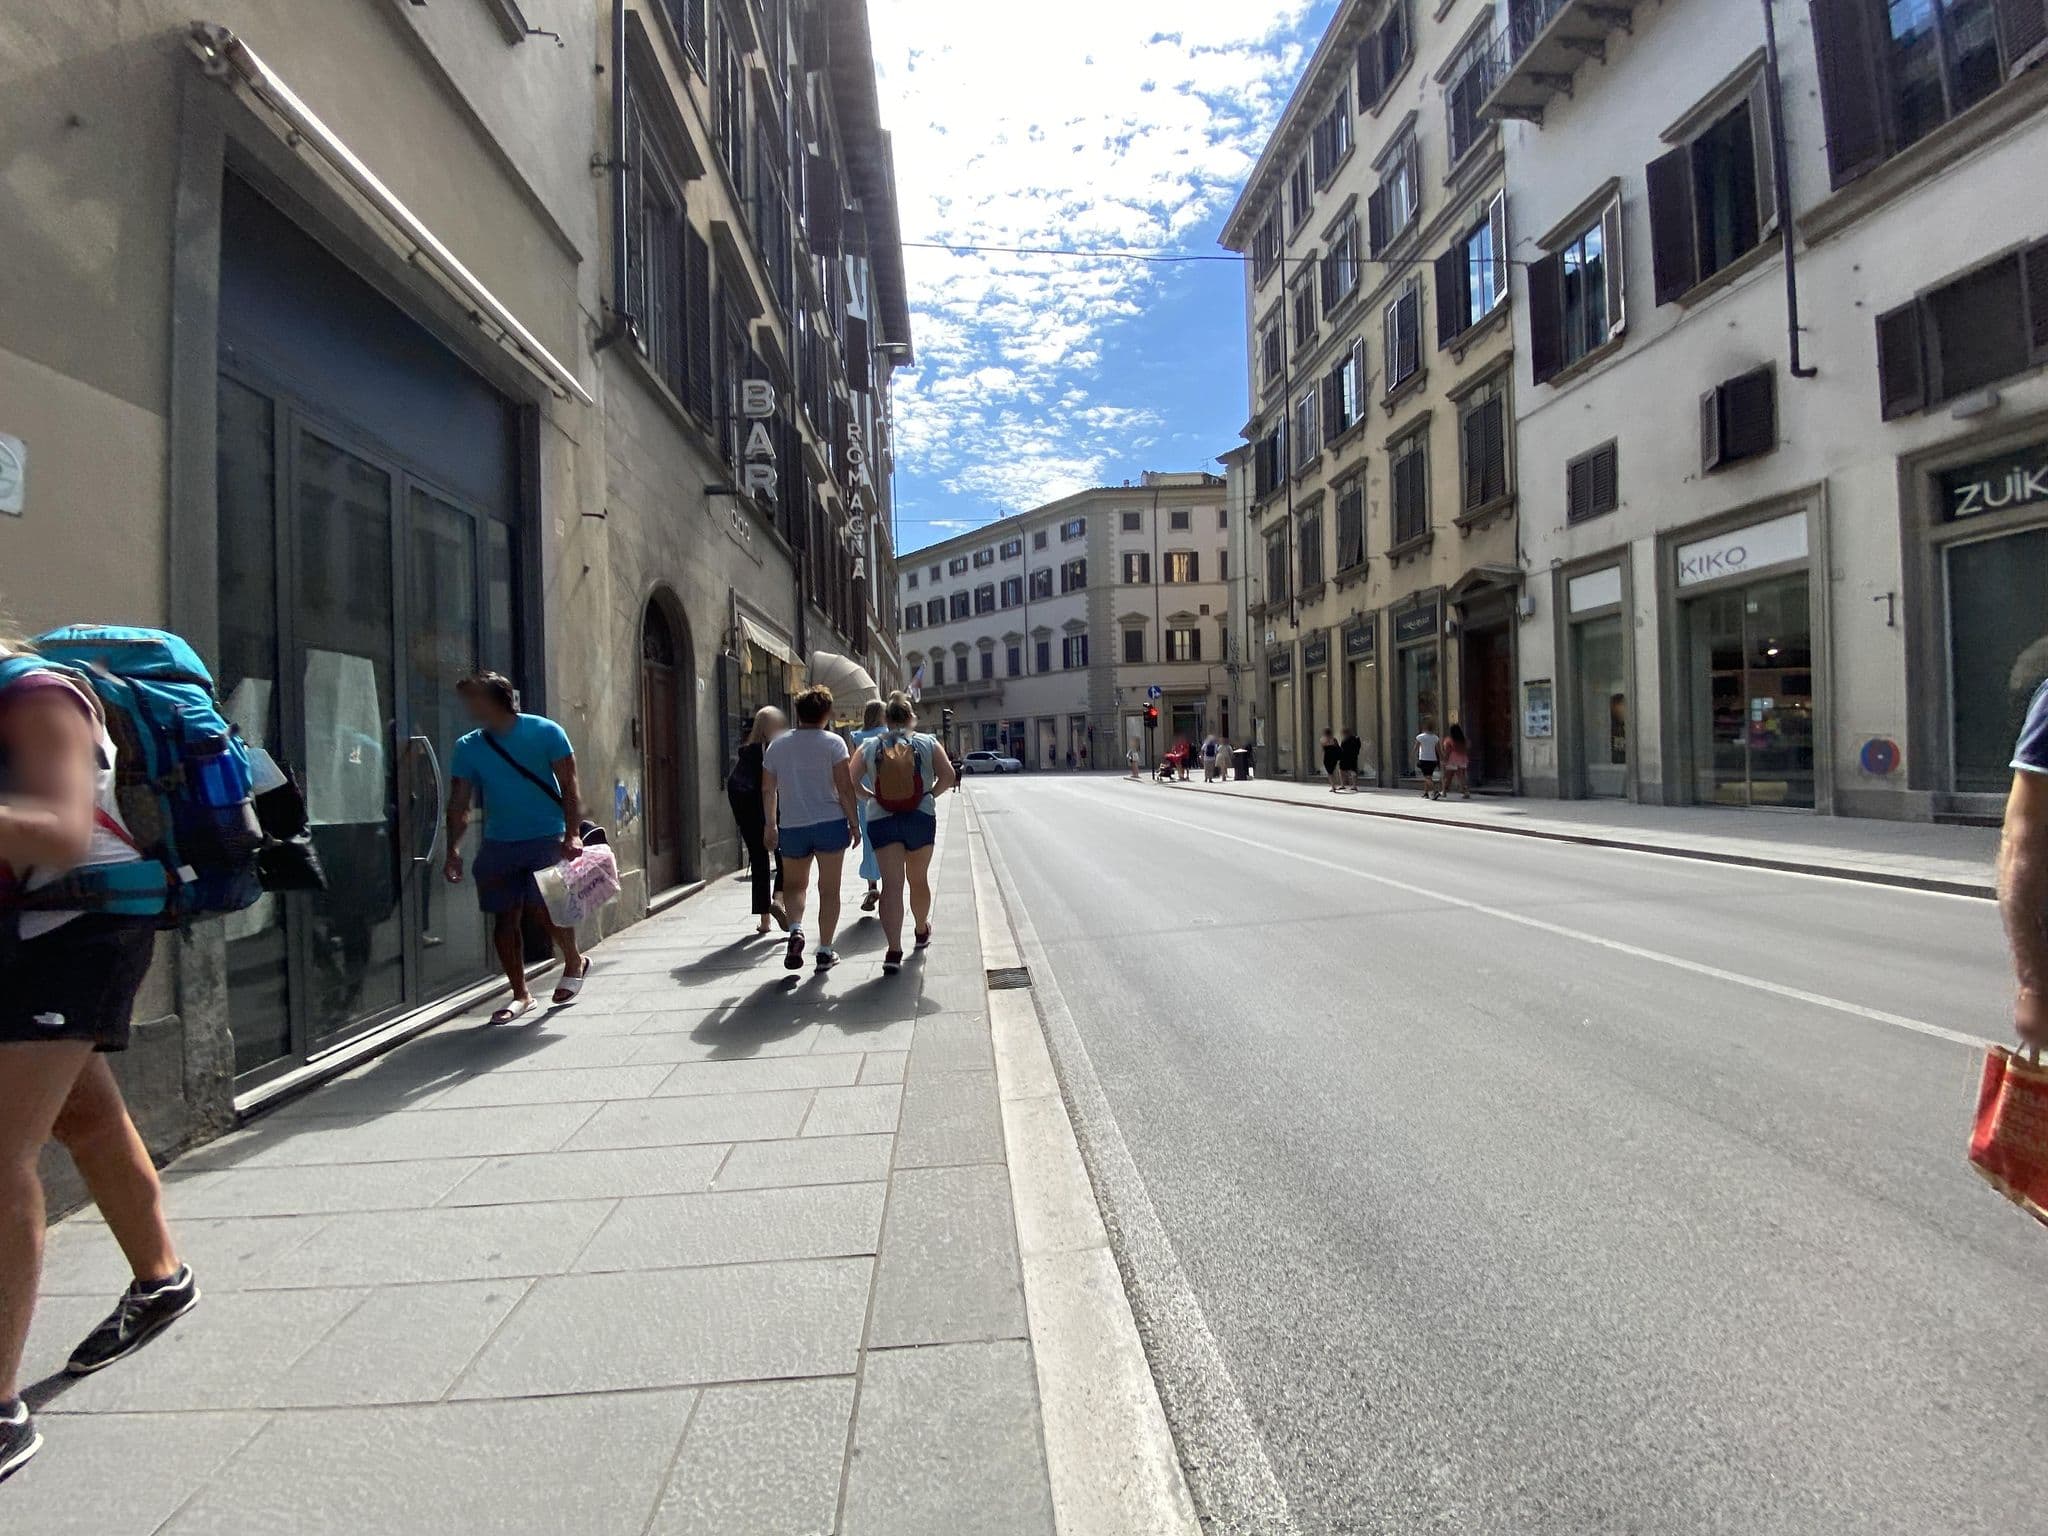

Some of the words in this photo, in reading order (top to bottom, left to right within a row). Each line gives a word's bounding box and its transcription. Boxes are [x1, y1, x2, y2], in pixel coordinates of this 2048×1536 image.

[742, 379, 778, 501] BAR
[847, 423, 866, 580] ROMAGNA
[1680, 546, 1746, 577] KIKO
